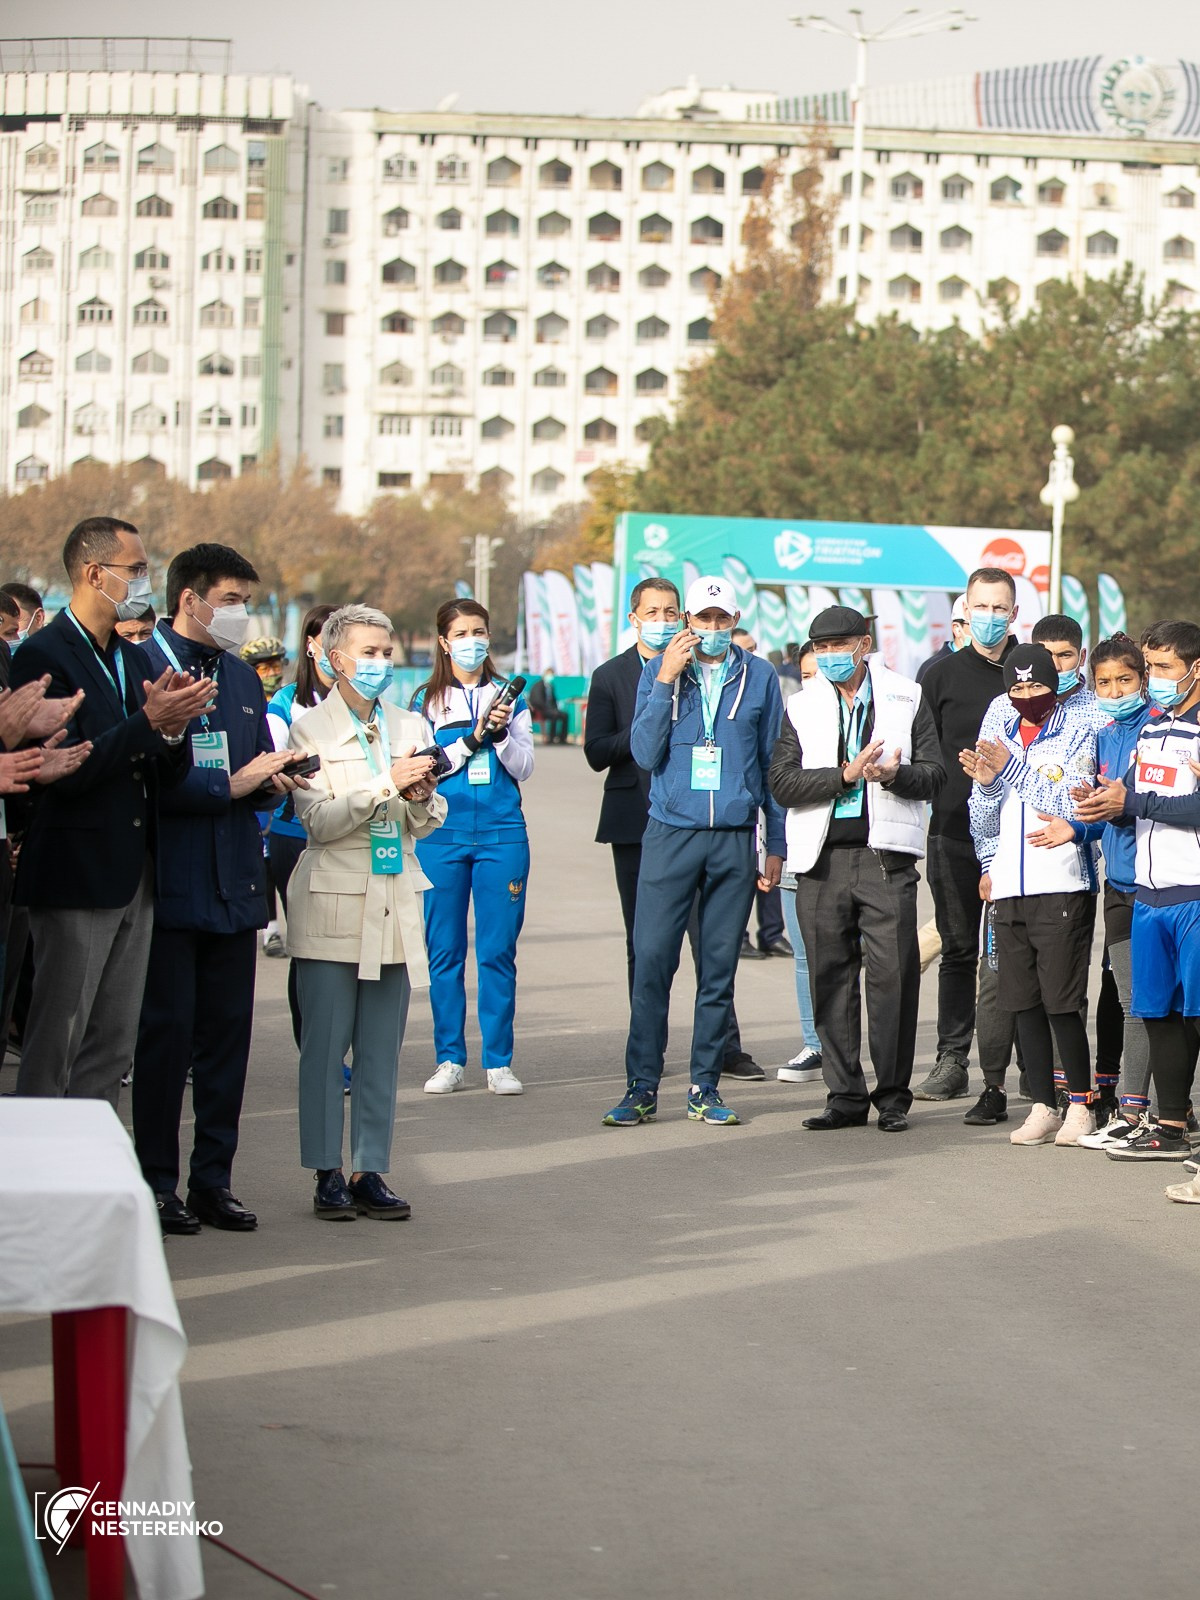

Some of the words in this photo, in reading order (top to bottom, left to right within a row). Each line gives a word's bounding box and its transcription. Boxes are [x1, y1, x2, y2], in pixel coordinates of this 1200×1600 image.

[198, 759, 225, 769] VIP
[695, 767, 717, 778] OC
[1144, 766, 1166, 783] 018
[375, 846, 398, 859] OC
